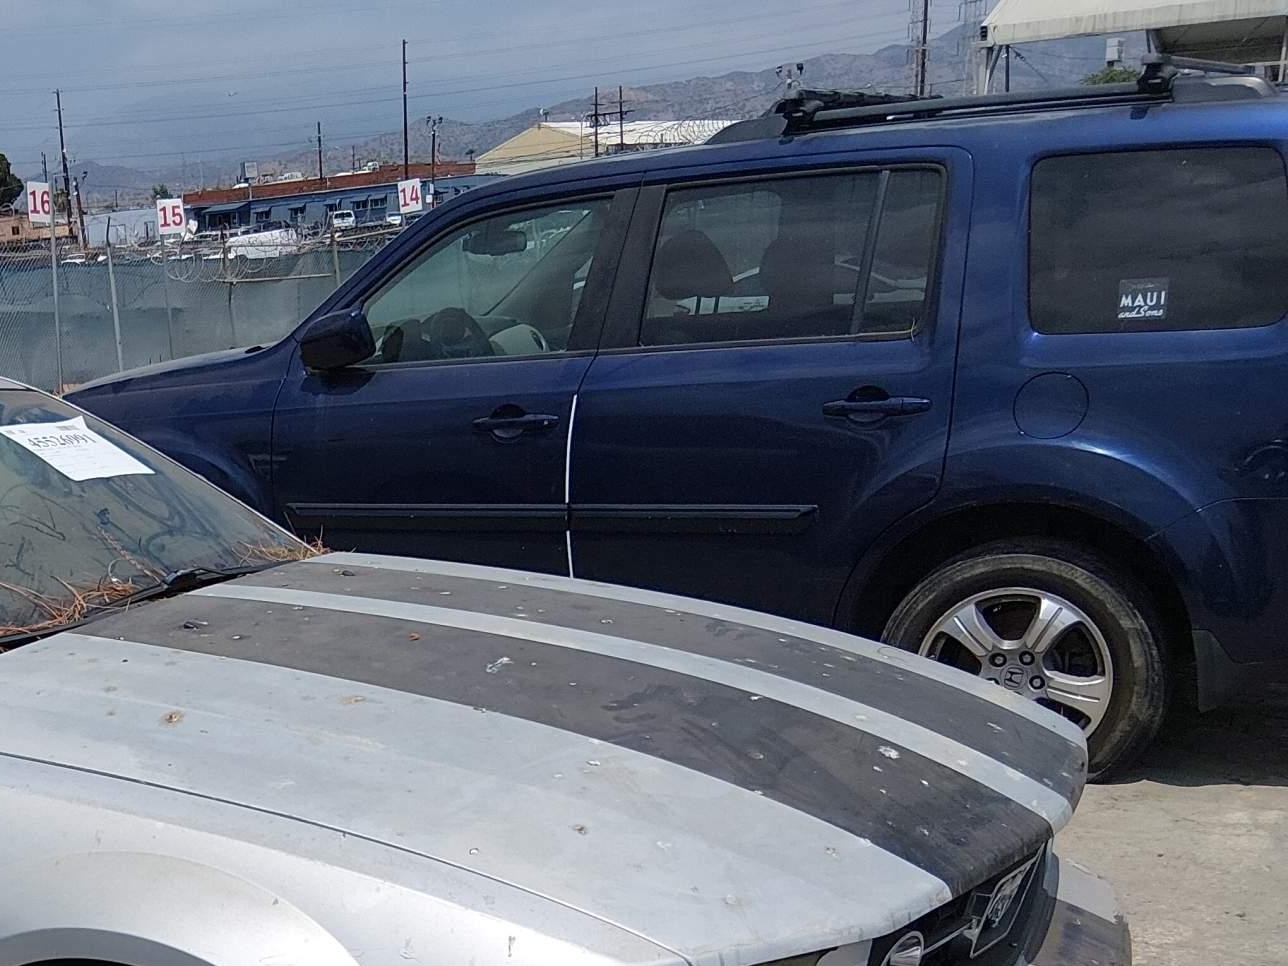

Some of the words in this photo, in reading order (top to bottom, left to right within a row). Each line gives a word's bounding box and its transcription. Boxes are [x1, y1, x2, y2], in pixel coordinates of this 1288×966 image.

[29, 190, 51, 215] 16
[400, 185, 420, 208] 14
[159, 205, 183, 227] 15
[1119, 291, 1166, 307] MAUI
